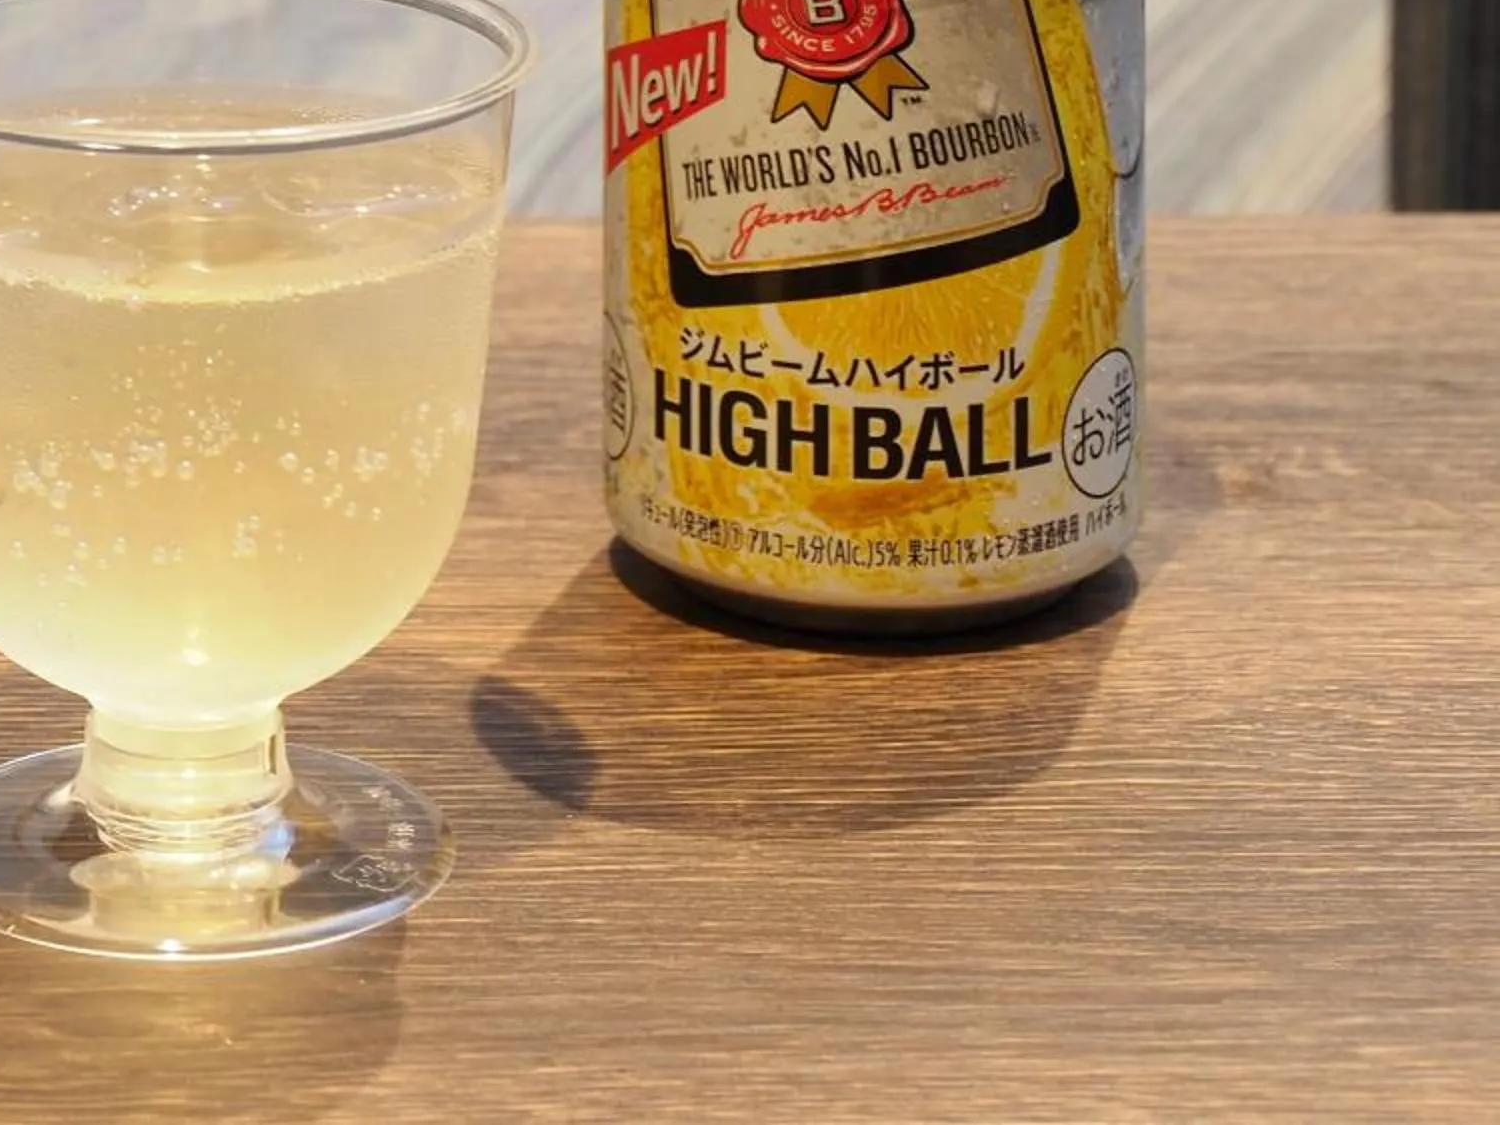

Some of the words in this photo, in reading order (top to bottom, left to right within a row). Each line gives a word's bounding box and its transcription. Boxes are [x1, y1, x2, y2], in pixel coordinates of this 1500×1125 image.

[771, 13, 837, 53] SINCE
[844, 3, 878, 45] 1795
[611, 30, 719, 155] New!
[681, 156, 718, 201] THE
[719, 144, 836, 195] WORLD'S
[908, 111, 1031, 171] BOURBON
[729, 200, 853, 261] James
[898, 175, 1009, 209] Beam
[678, 325, 1026, 392] ジムビームハイボール
[653, 367, 831, 479] HIGH
[853, 396, 1053, 482] BALL
[1072, 383, 1133, 467] お酒
